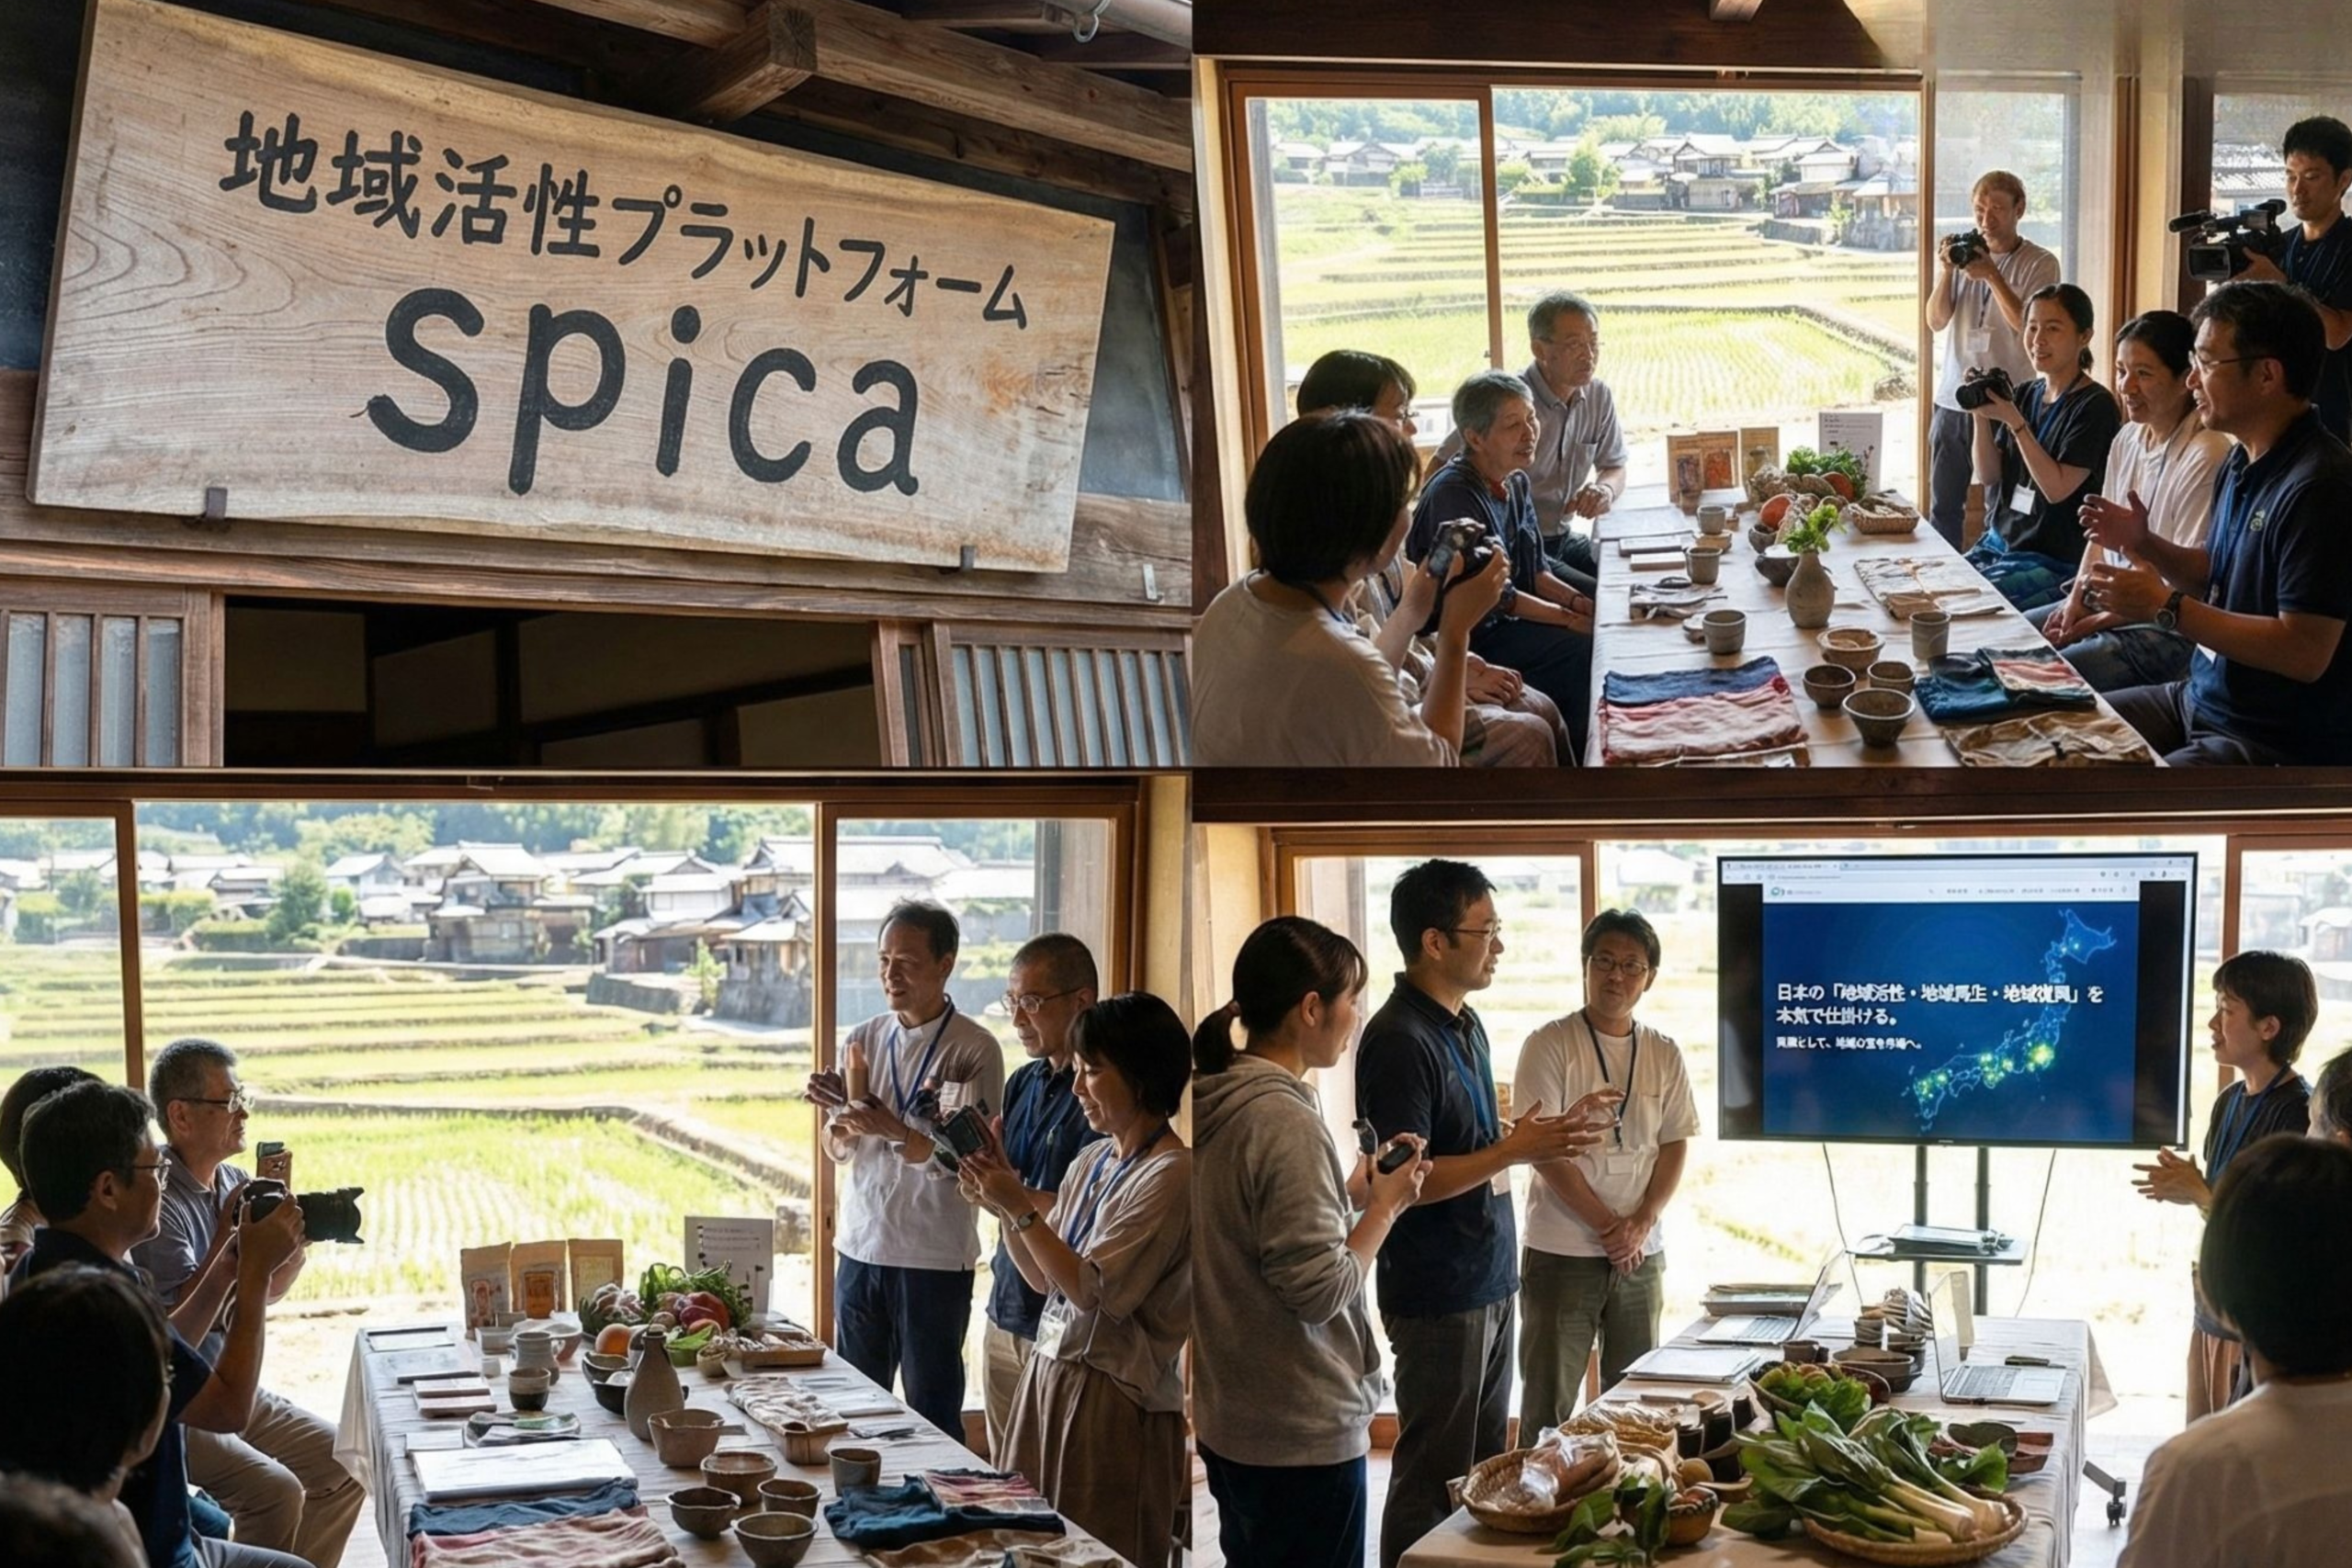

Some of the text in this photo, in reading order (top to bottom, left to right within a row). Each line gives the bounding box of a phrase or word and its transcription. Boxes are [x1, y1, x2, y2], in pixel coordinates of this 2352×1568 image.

[218, 110, 1028, 331] 地域活性プラットフォーム
[1776, 1006, 1898, 1026] 本気で仕掛ける。
